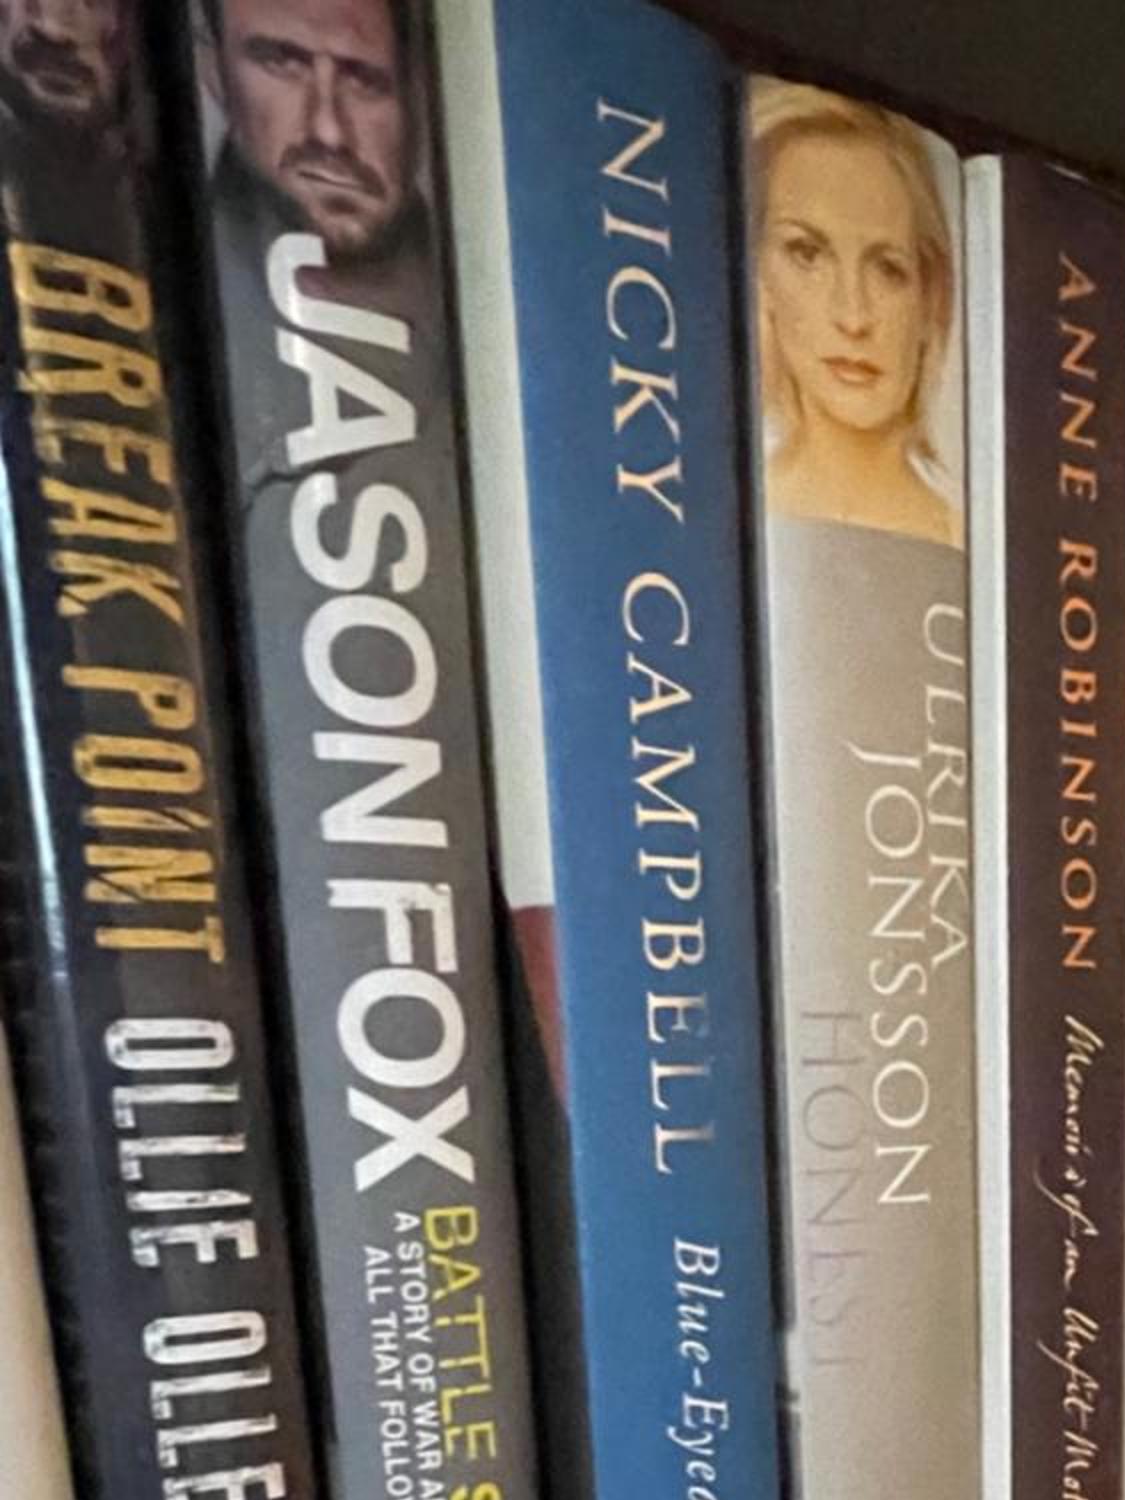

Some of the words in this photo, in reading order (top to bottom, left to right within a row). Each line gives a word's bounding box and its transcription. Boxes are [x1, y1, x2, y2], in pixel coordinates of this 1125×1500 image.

[6, 241, 188, 625] BREAK
[596, 98, 686, 525] NICKY
[1057, 252, 1098, 503] ANNE
[265, 231, 450, 850] JASON
[62, 664, 225, 963] POINT
[622, 571, 717, 1175] CAMPBELL
[922, 601, 967, 970] ULRIKA
[1058, 540, 1098, 970] ROBINSON
[325, 878, 476, 1192] FOX
[846, 738, 934, 1207] JONSSON
[103, 1016, 258, 1269] OLLIE
[393, 1211, 411, 1232] A
[799, 1008, 868, 1372] HONEST
[1063, 1014, 1104, 1188] Memoirs
[364, 1245, 390, 1304] ALL
[371, 1315, 402, 1394] THAT
[397, 1241, 430, 1344] STORY
[407, 1352, 434, 1392] OF
[424, 1203, 498, 1462] BATTLE
[1036, 1307, 1100, 1429] Unfit
[1063, 1241, 1080, 1290] an
[413, 1399, 442, 1470] WAR
